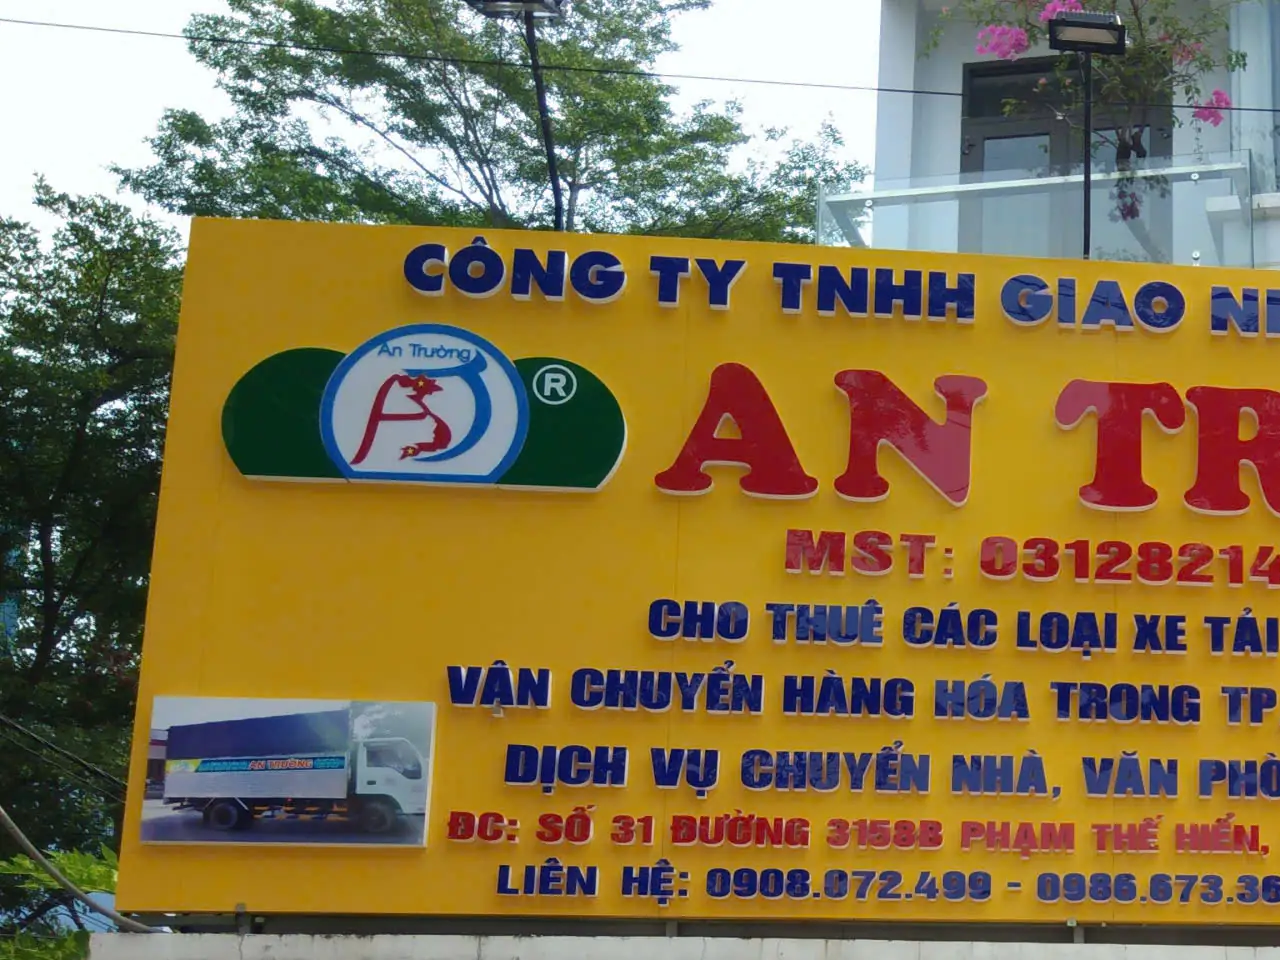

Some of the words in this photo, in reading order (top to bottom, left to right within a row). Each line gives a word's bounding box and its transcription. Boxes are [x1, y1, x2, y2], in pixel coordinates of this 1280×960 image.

[404, 235, 627, 303] CÔNG
[648, 255, 746, 312] TY
[773, 261, 976, 326] TNHH
[1000, 273, 1186, 333] GIAO
[378, 343, 402, 358] An
[408, 343, 472, 363] Trường
[654, 362, 988, 508] AN
[785, 528, 955, 579] MST:
[648, 599, 750, 644] CHO
[766, 598, 884, 647] THUÊ
[902, 603, 998, 650] CÁC
[1016, 610, 1118, 660] LOẠI
[1133, 614, 1187, 655] XE
[1204, 607, 1280, 658] TẢI
[448, 660, 552, 716] VẬN
[570, 660, 765, 716] CHUYỂN
[782, 669, 916, 719] HÀNG
[933, 673, 1031, 721] HÓA
[1050, 681, 1201, 726] TRONG
[504, 744, 628, 795] DỊCH
[650, 748, 720, 799] VỤ
[740, 740, 932, 795] CHUYỂN
[952, 748, 1061, 800] NHÀ,
[1081, 750, 1179, 798] VĂN
[447, 811, 519, 843] ĐC:
[534, 804, 597, 846] SỐ
[610, 814, 655, 846] 31
[669, 809, 812, 849] ĐƯỜNG
[826, 817, 944, 850] 3158B
[960, 821, 1077, 860] PHẠM
[1091, 815, 1165, 854] THẾ
[496, 857, 598, 898] LIÊN
[621, 858, 691, 907] HỆ:
[705, 867, 993, 902] 0908.072.499
